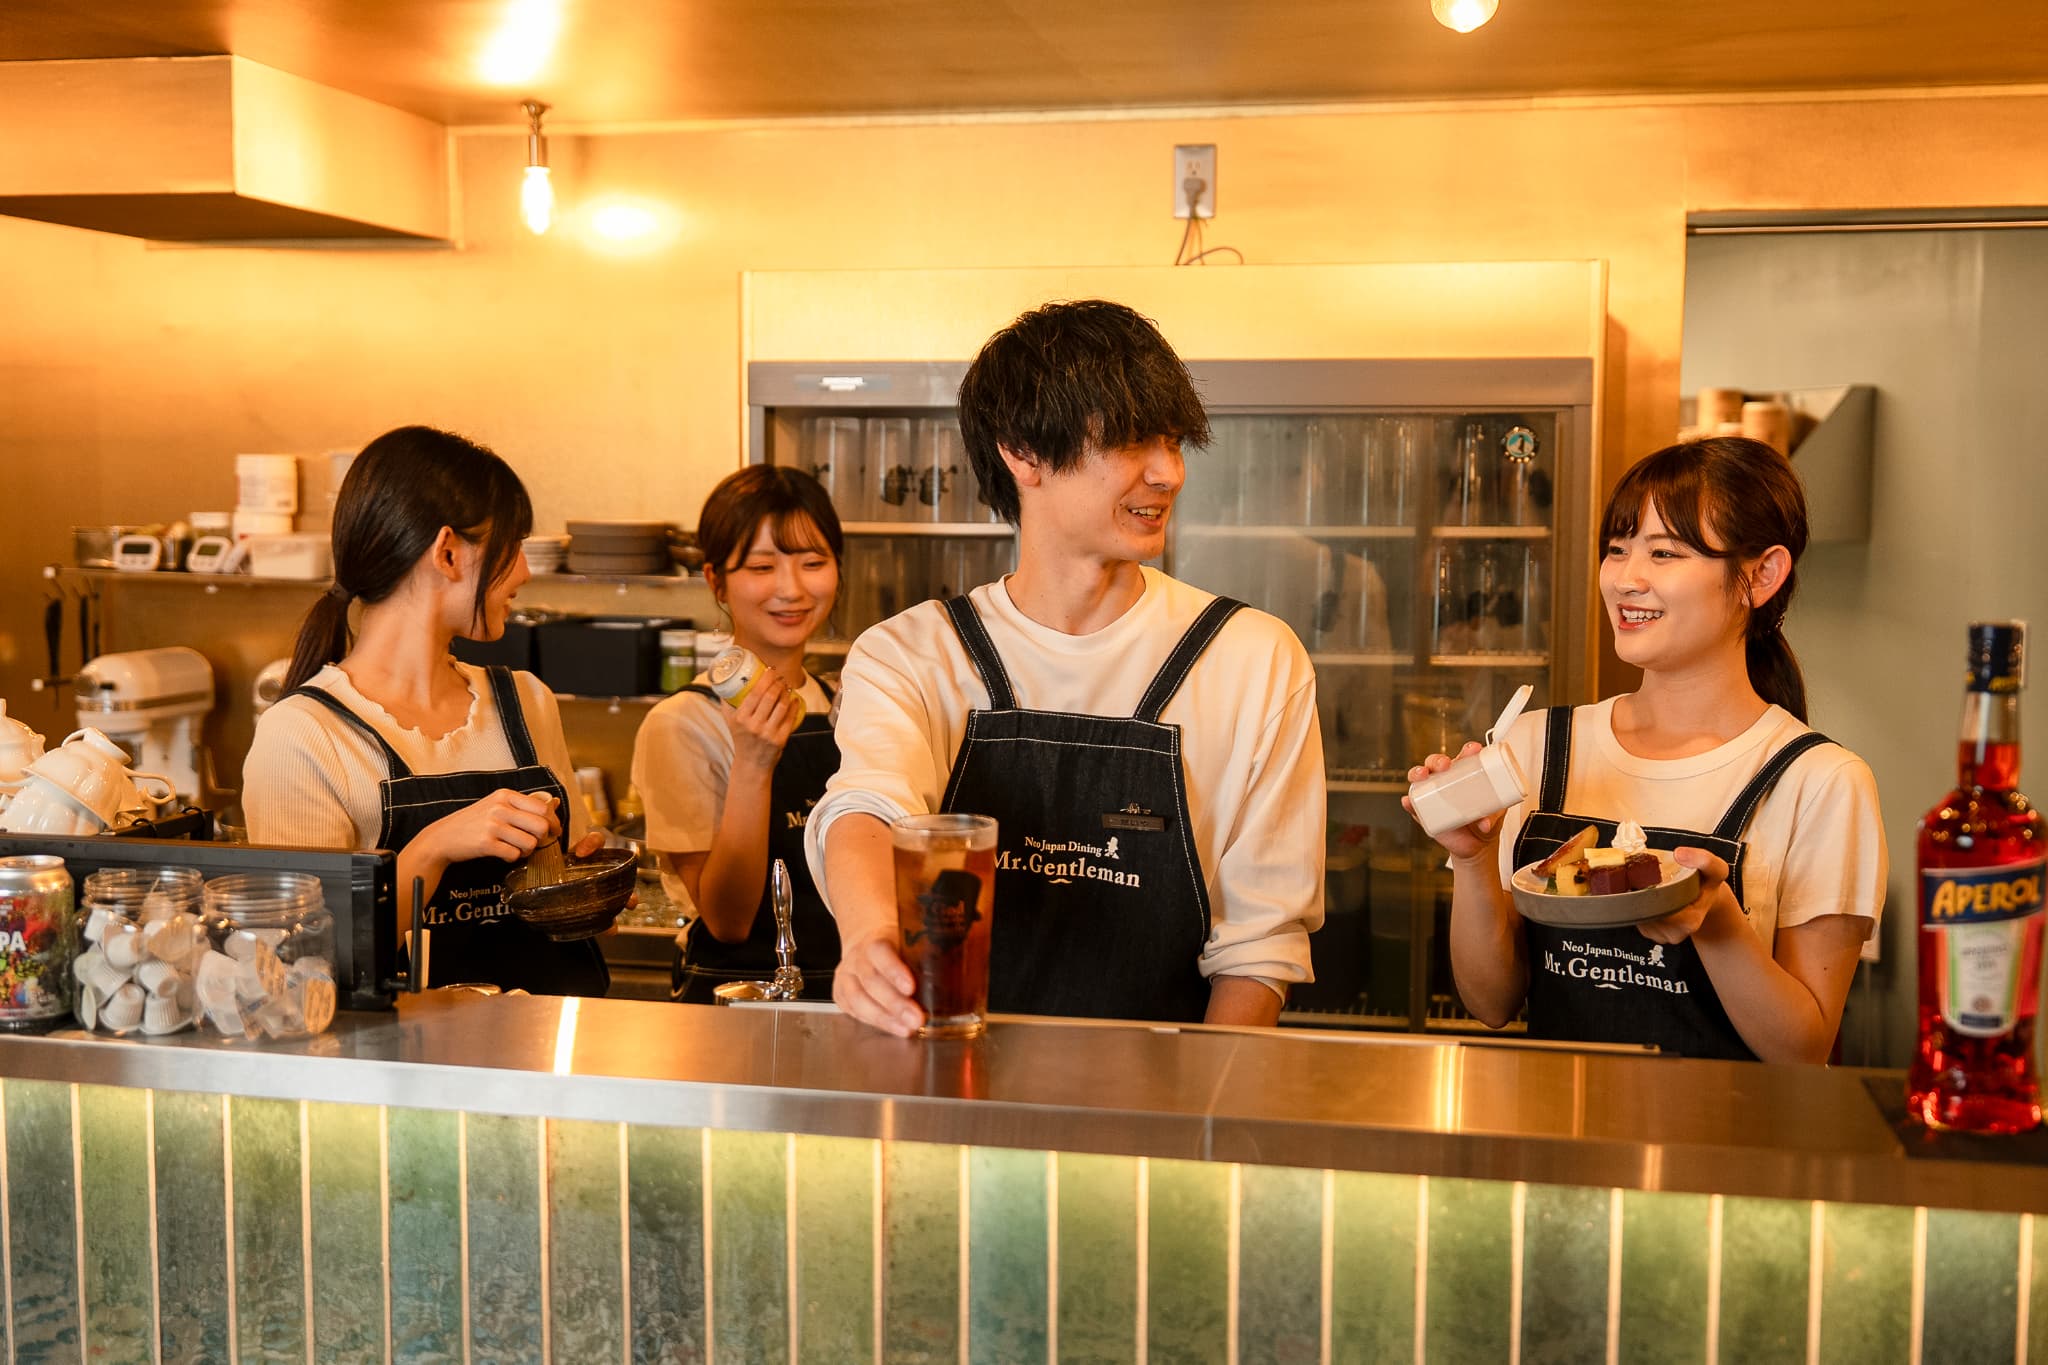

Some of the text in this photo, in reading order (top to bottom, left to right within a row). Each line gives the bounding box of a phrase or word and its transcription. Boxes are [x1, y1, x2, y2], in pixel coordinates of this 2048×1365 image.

[1024, 836, 1102, 857] Neo Japan Dining
[1931, 874, 2042, 918] APEROL
[422, 902, 515, 925] Mr.Gentl
[1562, 940, 1646, 966] Neo Japan Dining
